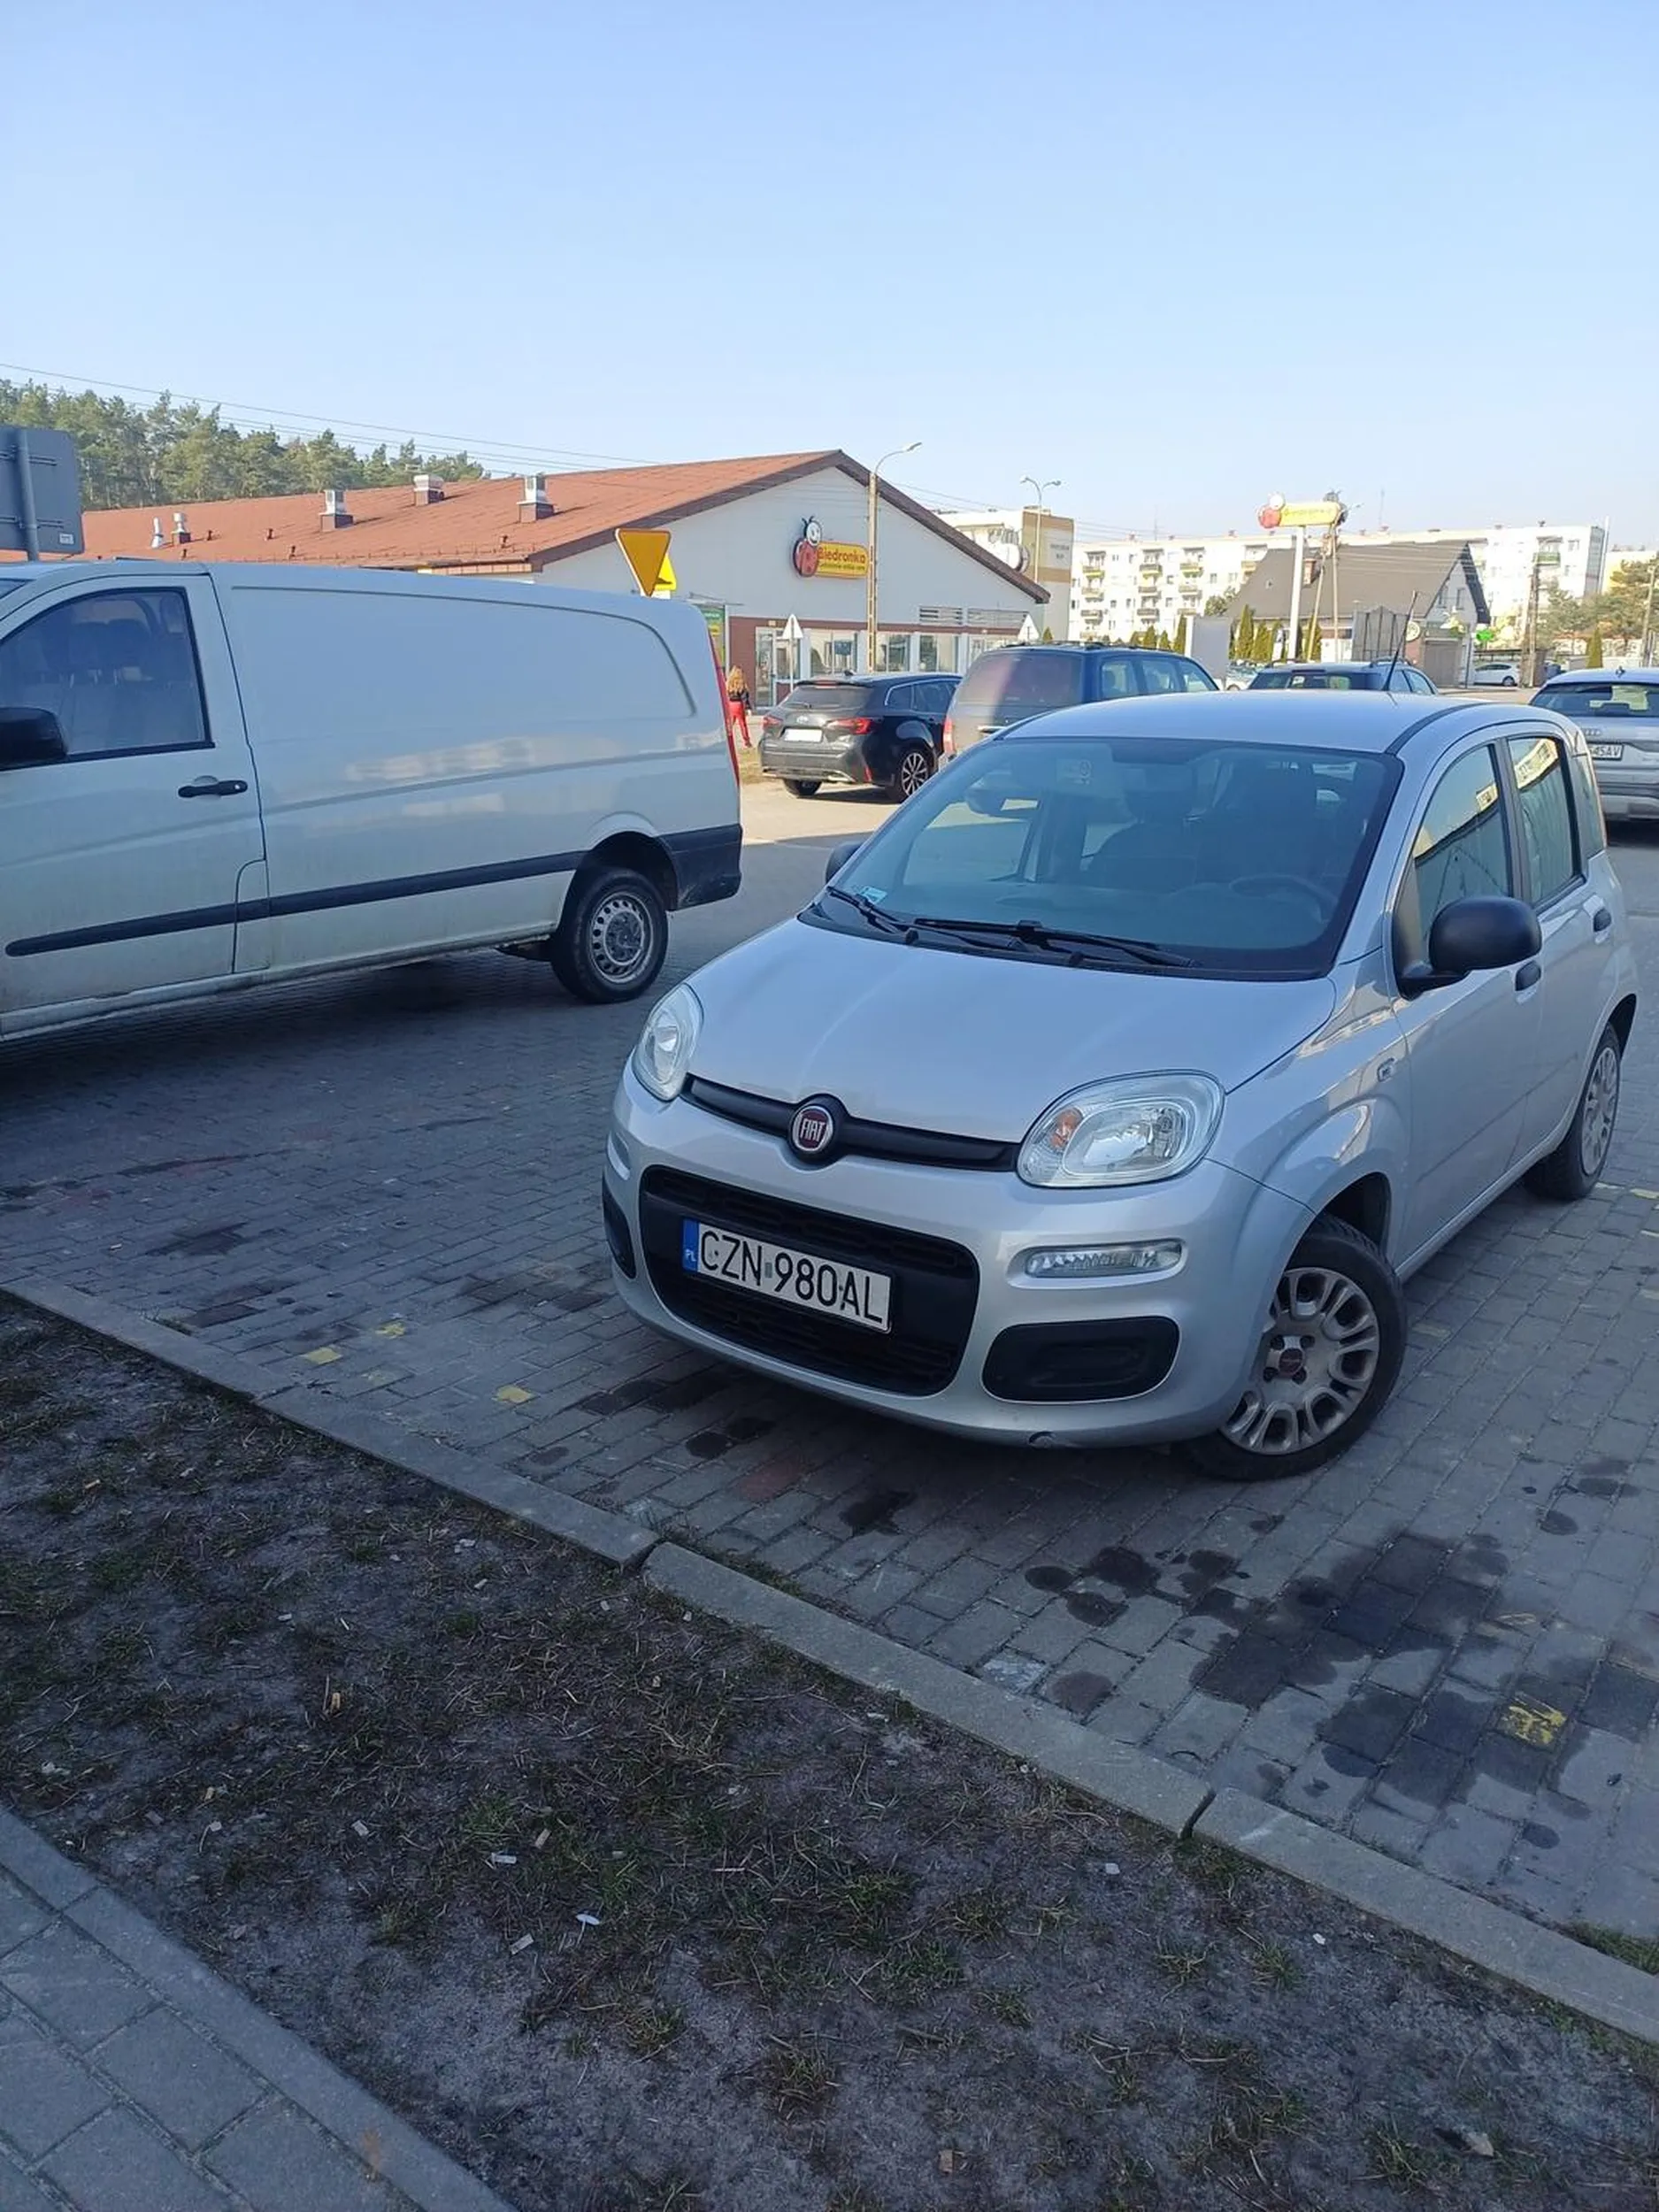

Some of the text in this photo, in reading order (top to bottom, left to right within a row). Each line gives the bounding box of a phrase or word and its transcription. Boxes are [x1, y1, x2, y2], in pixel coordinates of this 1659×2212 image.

[817, 546, 865, 565] Biedronka
[800, 1118, 826, 1142] FIAT
[685, 1248, 697, 1262] PL
[701, 1230, 883, 1324] CZN 980AL
